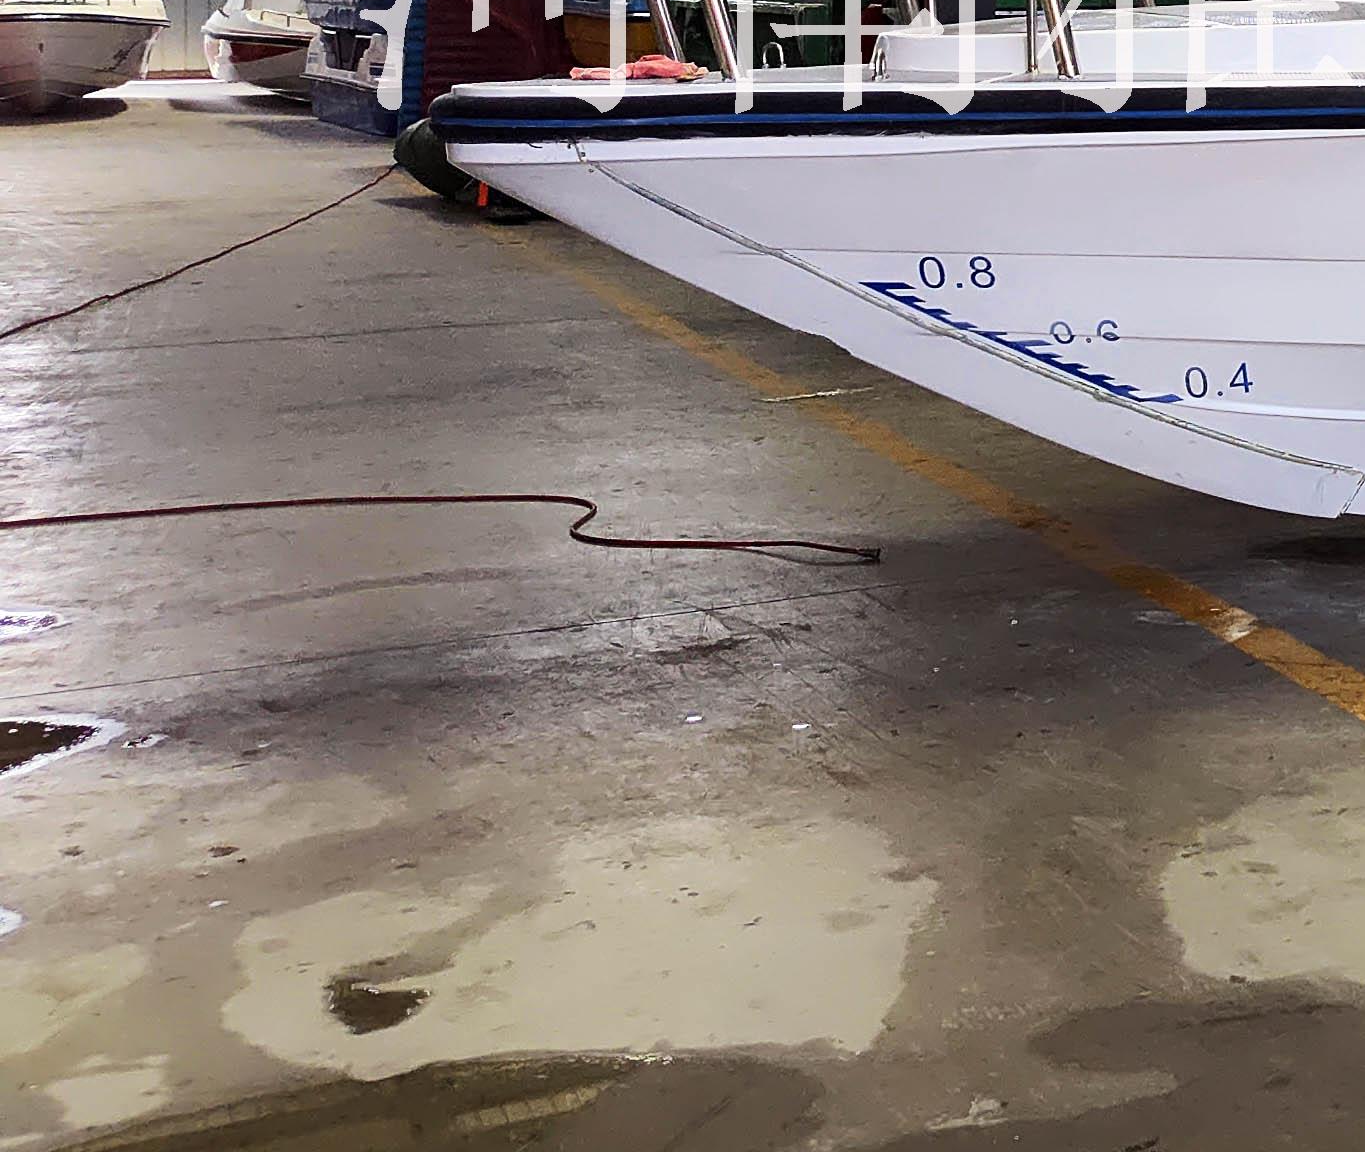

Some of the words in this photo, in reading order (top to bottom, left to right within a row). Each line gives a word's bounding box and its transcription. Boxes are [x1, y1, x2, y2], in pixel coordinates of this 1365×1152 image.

[918, 256, 996, 289] 0.8
[1050, 320, 1120, 344] 0.6
[1184, 362, 1254, 399] 0.4
